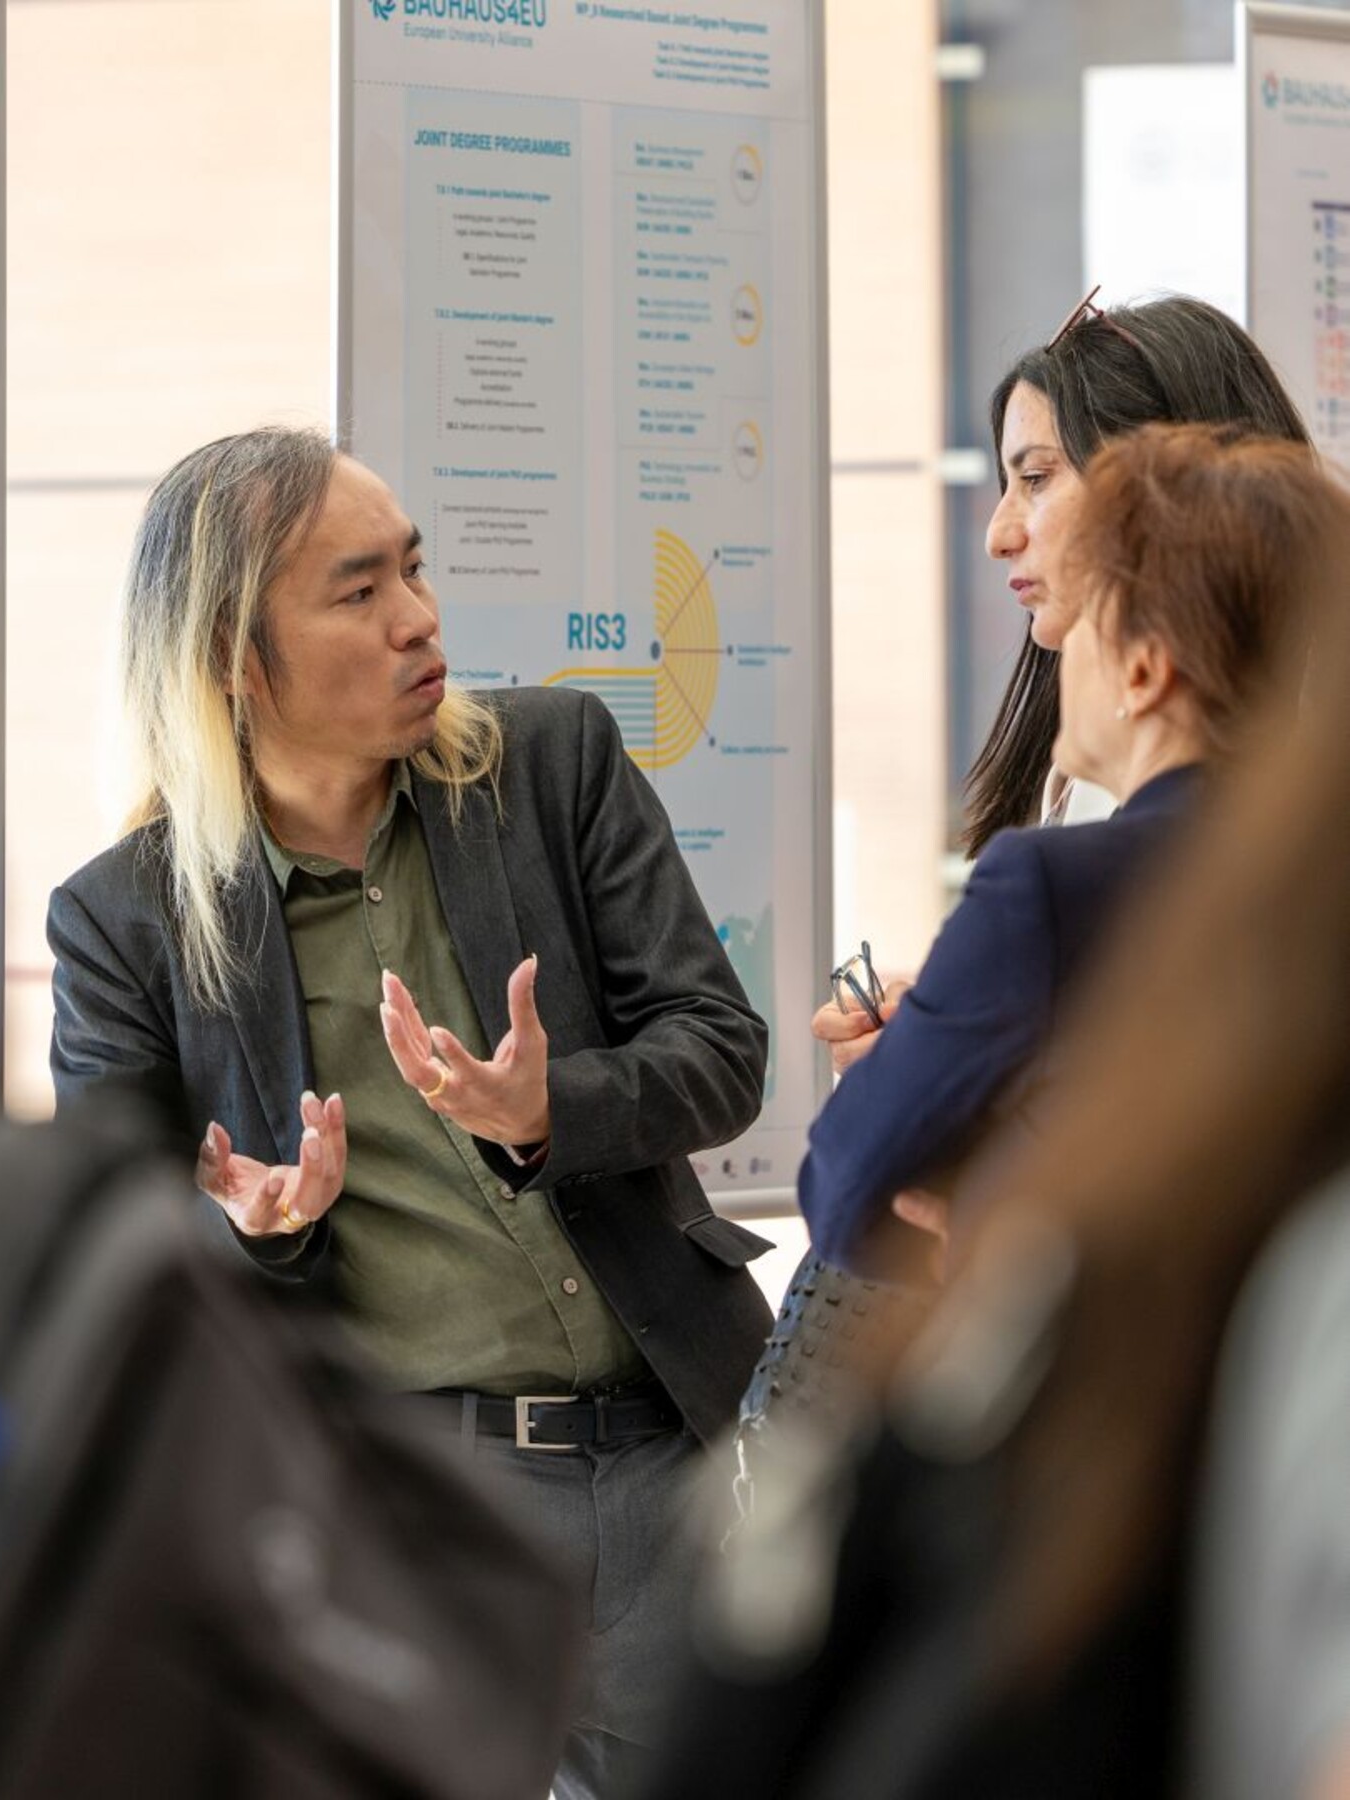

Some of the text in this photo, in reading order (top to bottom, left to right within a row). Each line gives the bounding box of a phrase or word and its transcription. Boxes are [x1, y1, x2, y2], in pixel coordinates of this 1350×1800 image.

[414, 130, 572, 158] JOINT DEGREE PROGRAMMES
[567, 612, 627, 651] RIS3
